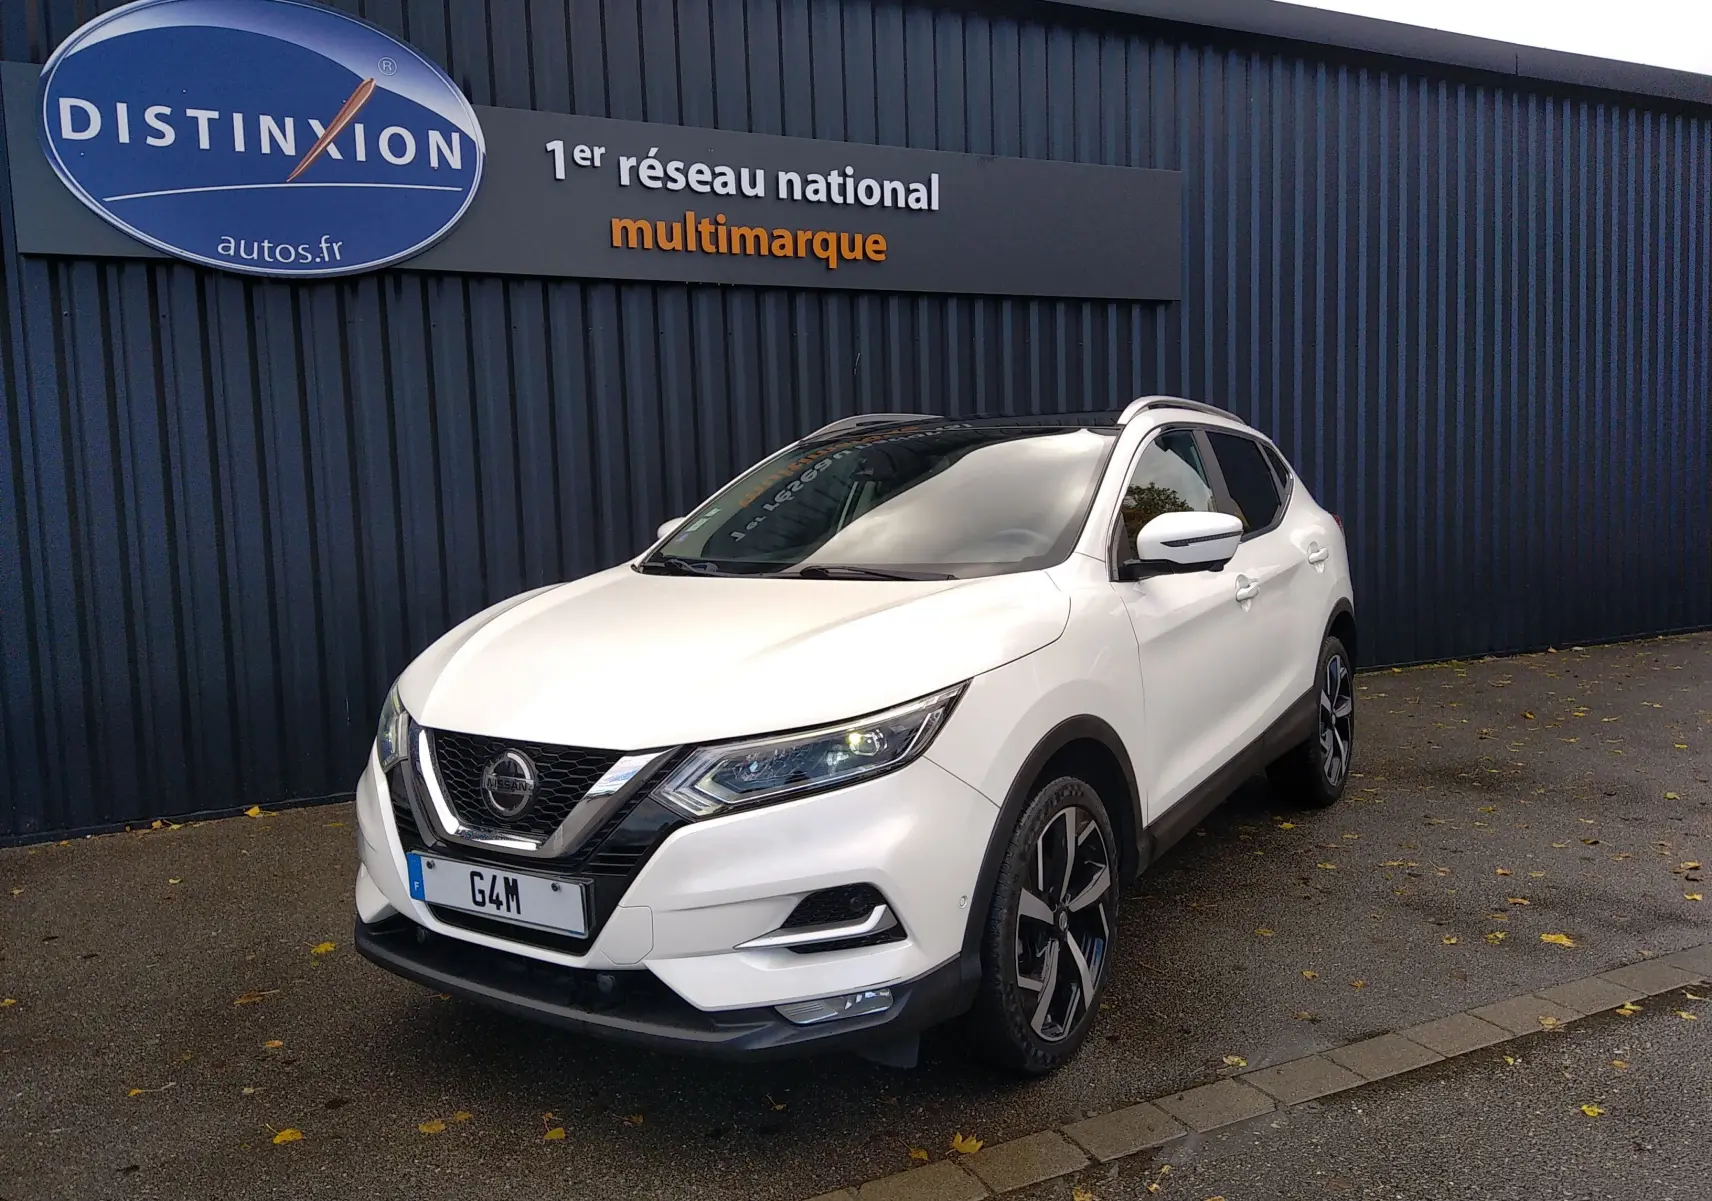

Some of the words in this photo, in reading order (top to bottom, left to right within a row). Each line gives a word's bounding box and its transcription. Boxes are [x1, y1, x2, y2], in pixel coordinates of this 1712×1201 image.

[58, 96, 463, 170] DISTINXION
[545, 139, 605, 180] 1er
[618, 147, 766, 198] réseau
[777, 165, 940, 211] national
[216, 235, 343, 264] autos.fr
[611, 211, 887, 268] multimarque
[414, 881, 420, 892] F
[469, 871, 521, 915] G4M
